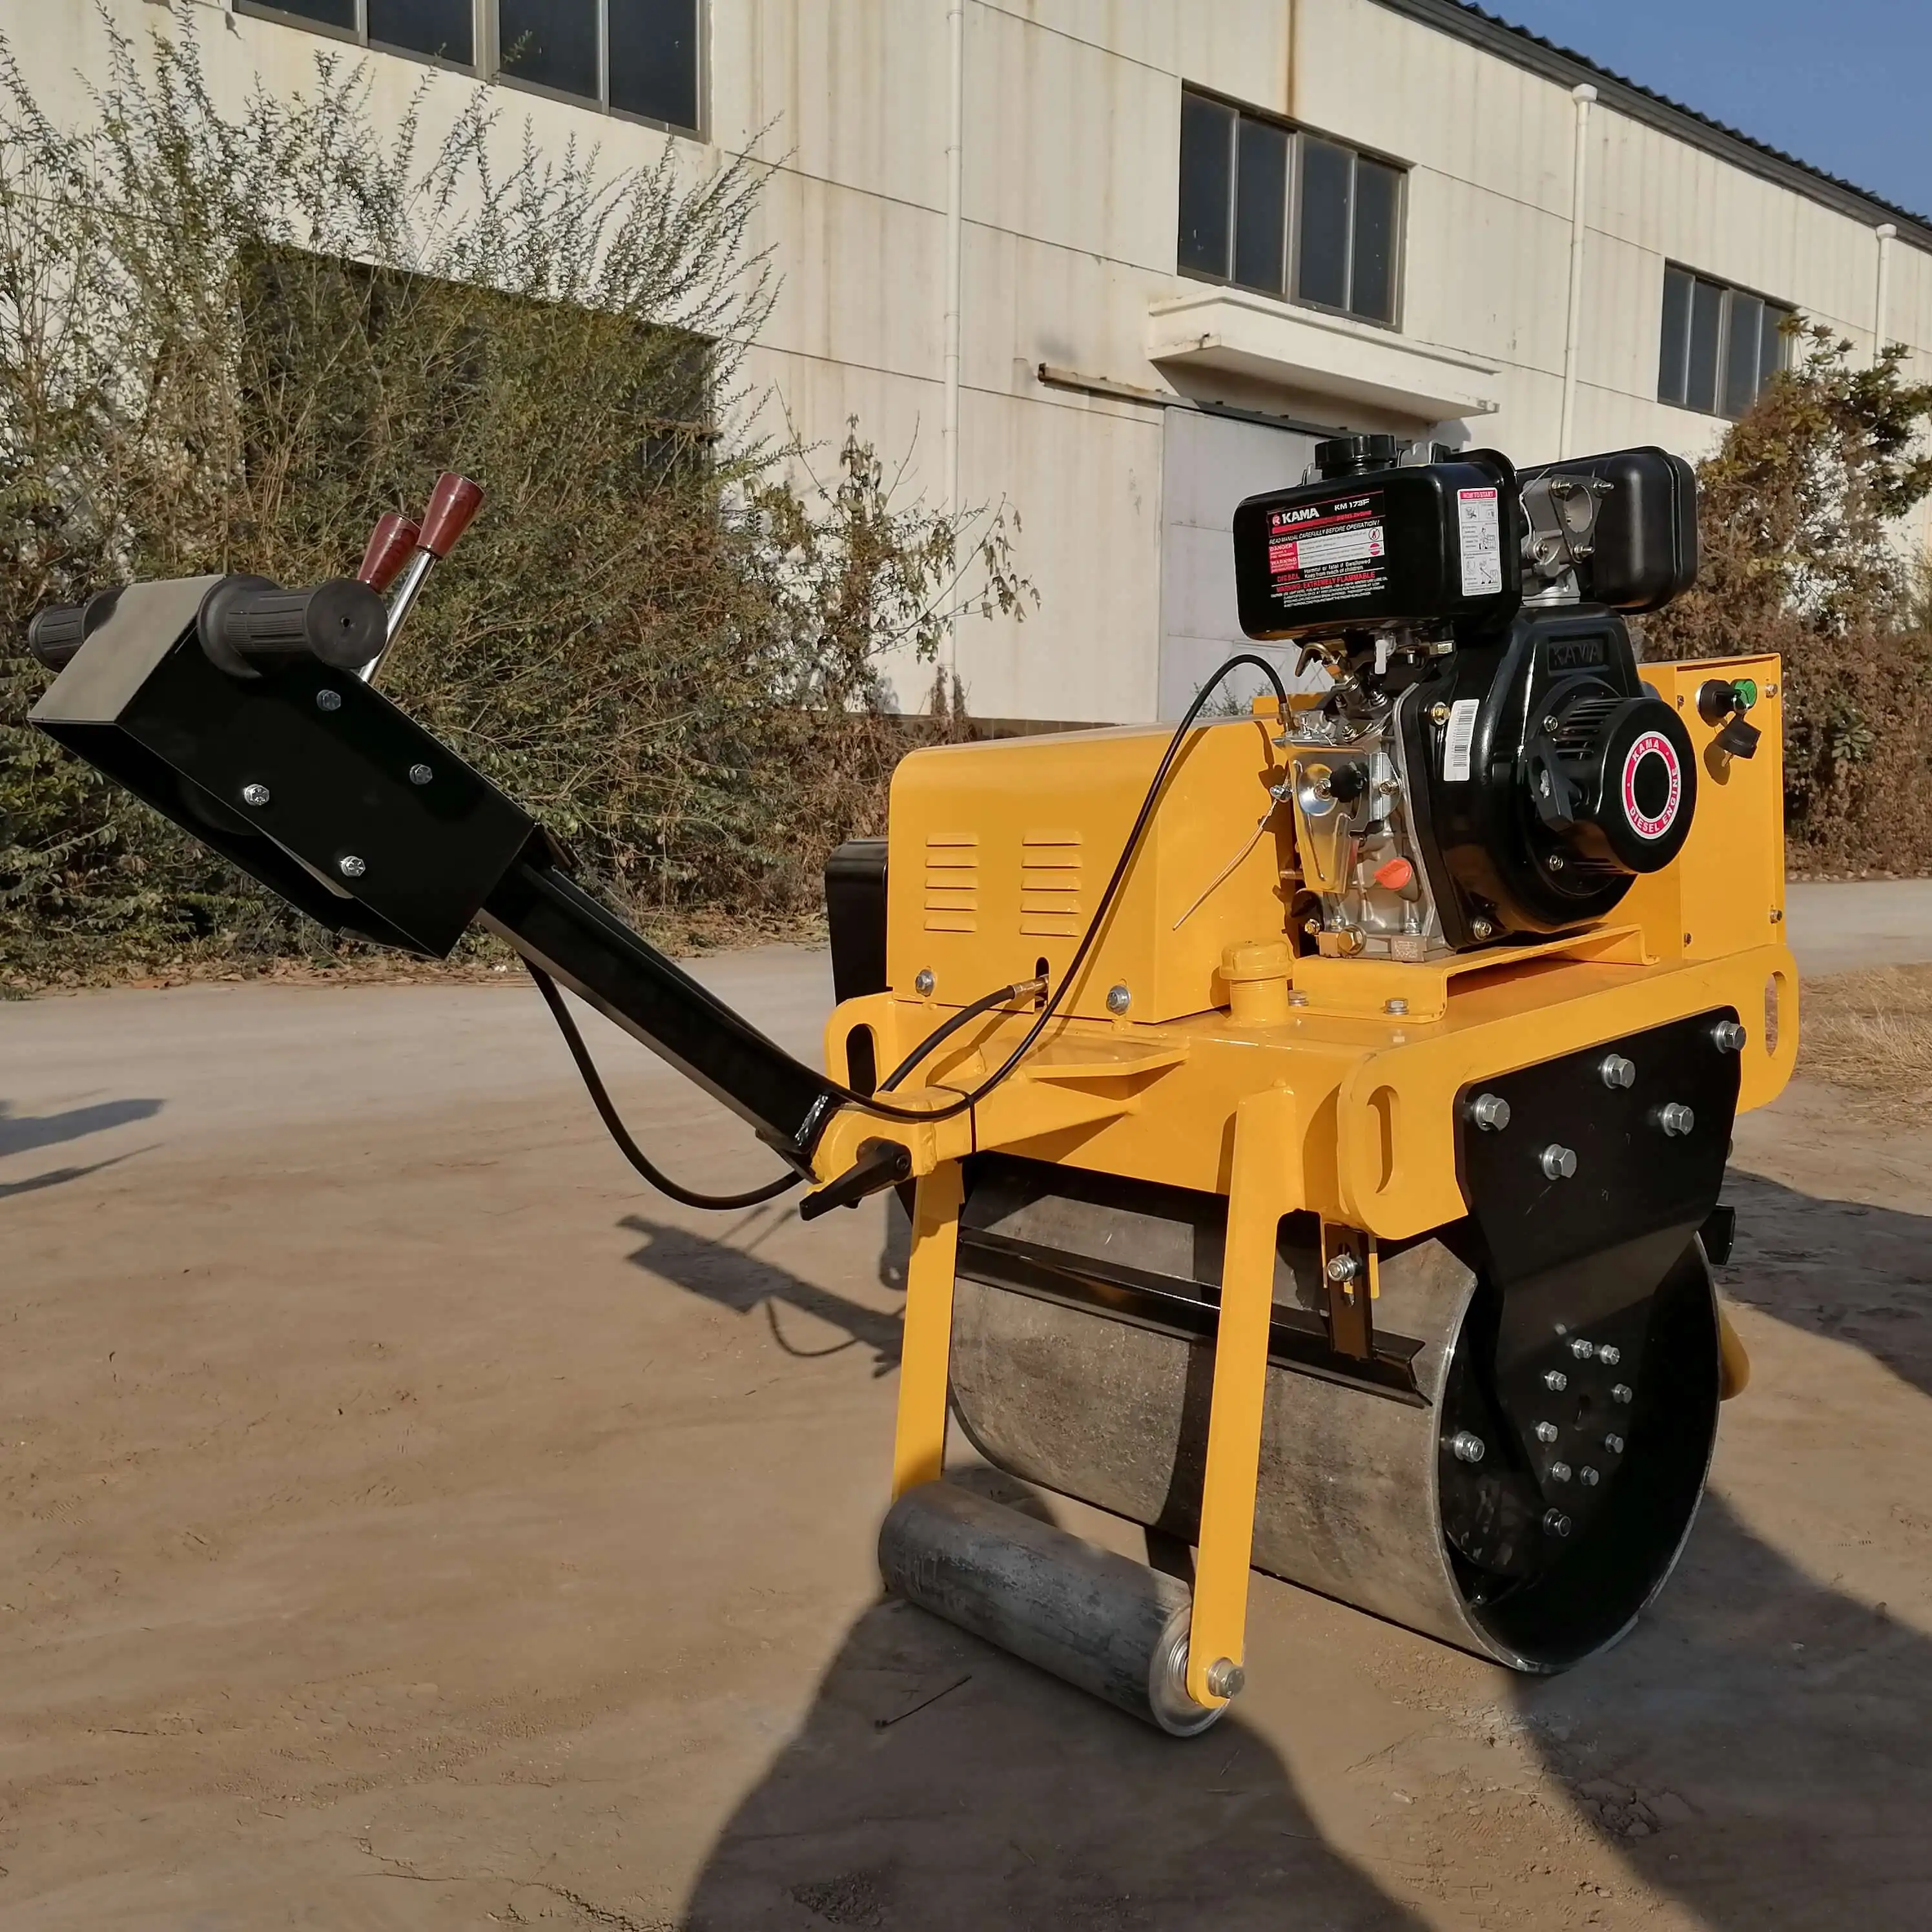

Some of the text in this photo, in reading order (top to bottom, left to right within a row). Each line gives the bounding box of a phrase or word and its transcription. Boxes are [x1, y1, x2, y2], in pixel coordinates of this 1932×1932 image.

[1334, 502, 1348, 511] KM
[1282, 508, 1320, 524] KAMA
[1299, 528, 1325, 539] CAREFULLY
[1326, 525, 1346, 535] BEFORE
[1269, 542, 1293, 551] DANGER
[1303, 578, 1337, 590] EXTREMELY
[1337, 571, 1376, 584] FLAMMABLE
[1631, 738, 1660, 762] KAMA
[1629, 766, 1679, 834] DIESEL ENGINE
